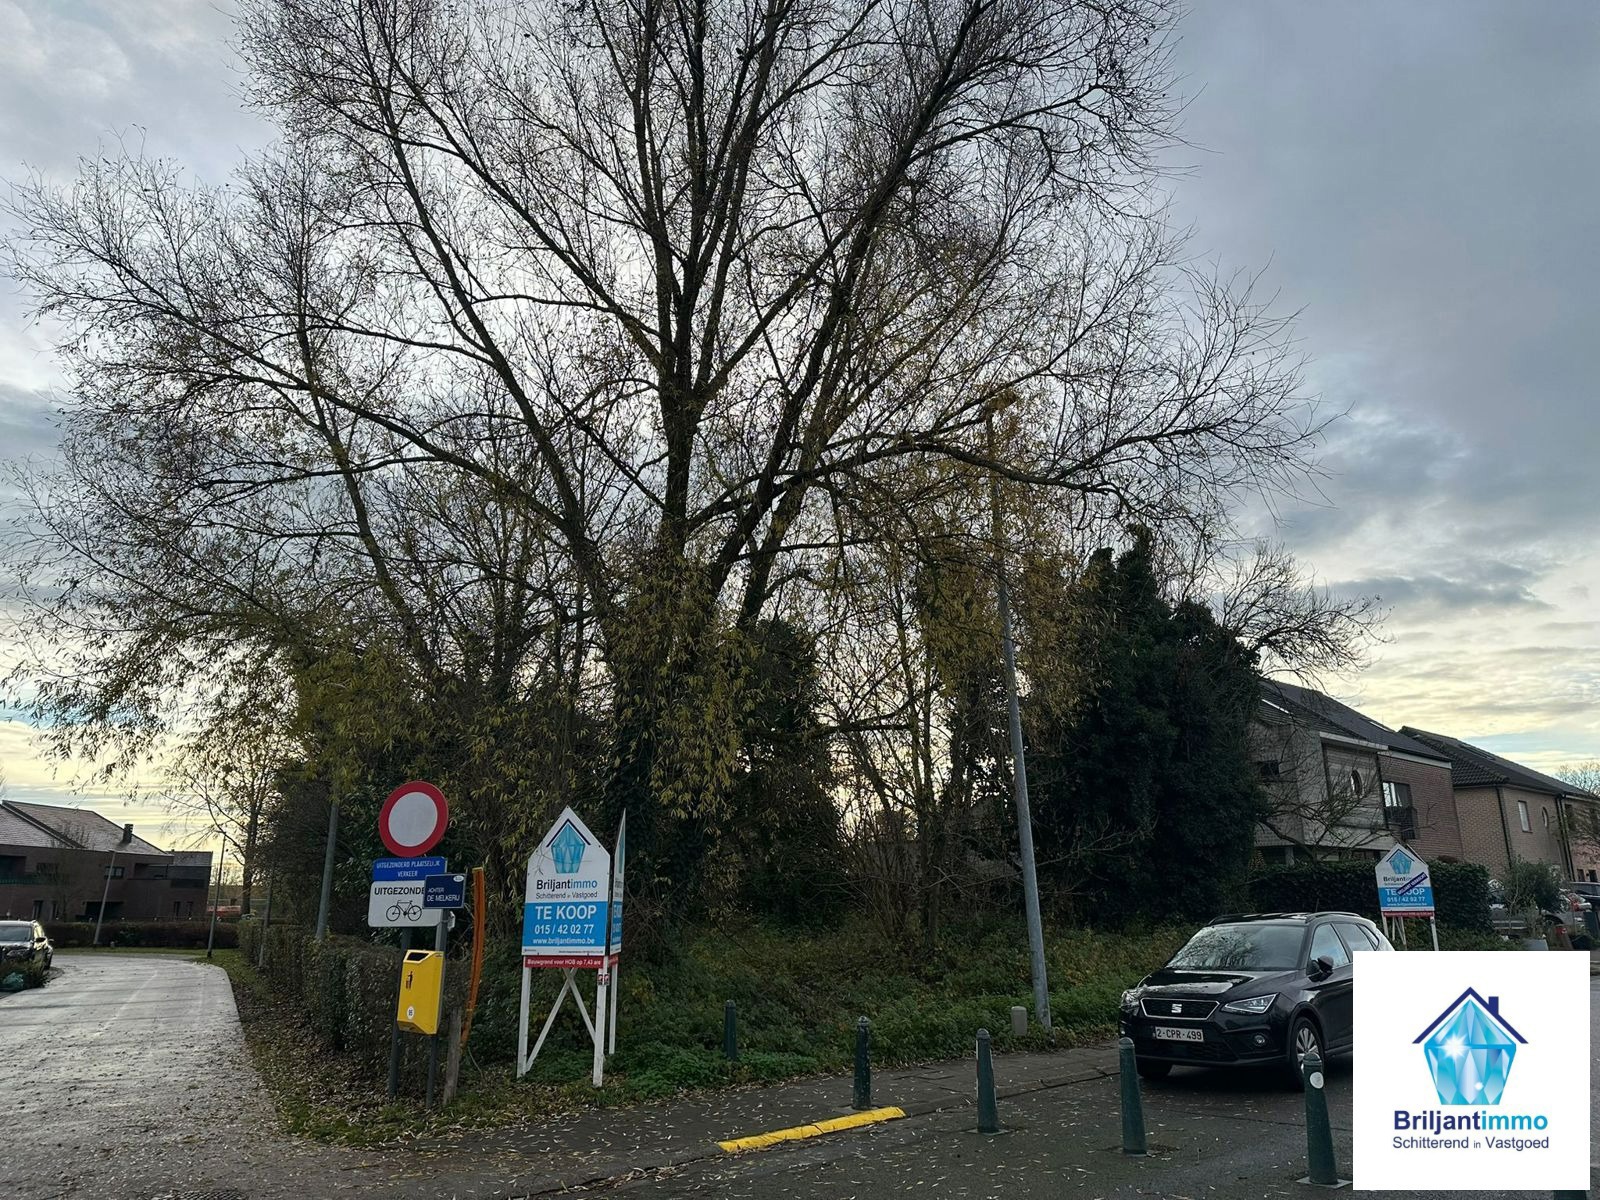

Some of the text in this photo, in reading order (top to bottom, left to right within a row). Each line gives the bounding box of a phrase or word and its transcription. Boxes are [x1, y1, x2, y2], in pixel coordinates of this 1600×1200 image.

[376, 861, 410, 869] UITGEZONDERD
[536, 879, 598, 891] Briljantimmo
[435, 894, 460, 902] MELKERIJ
[535, 892, 566, 900] Schitterend
[572, 891, 598, 900] Vastgoed
[535, 906, 552, 920] TE
[556, 905, 597, 920] KOOP
[534, 924, 550, 935] 015
[557, 924, 568, 934] 42
[570, 924, 581, 934] 02
[583, 924, 594, 934] 77
[532, 937, 595, 946] www.briljantimmo.be
